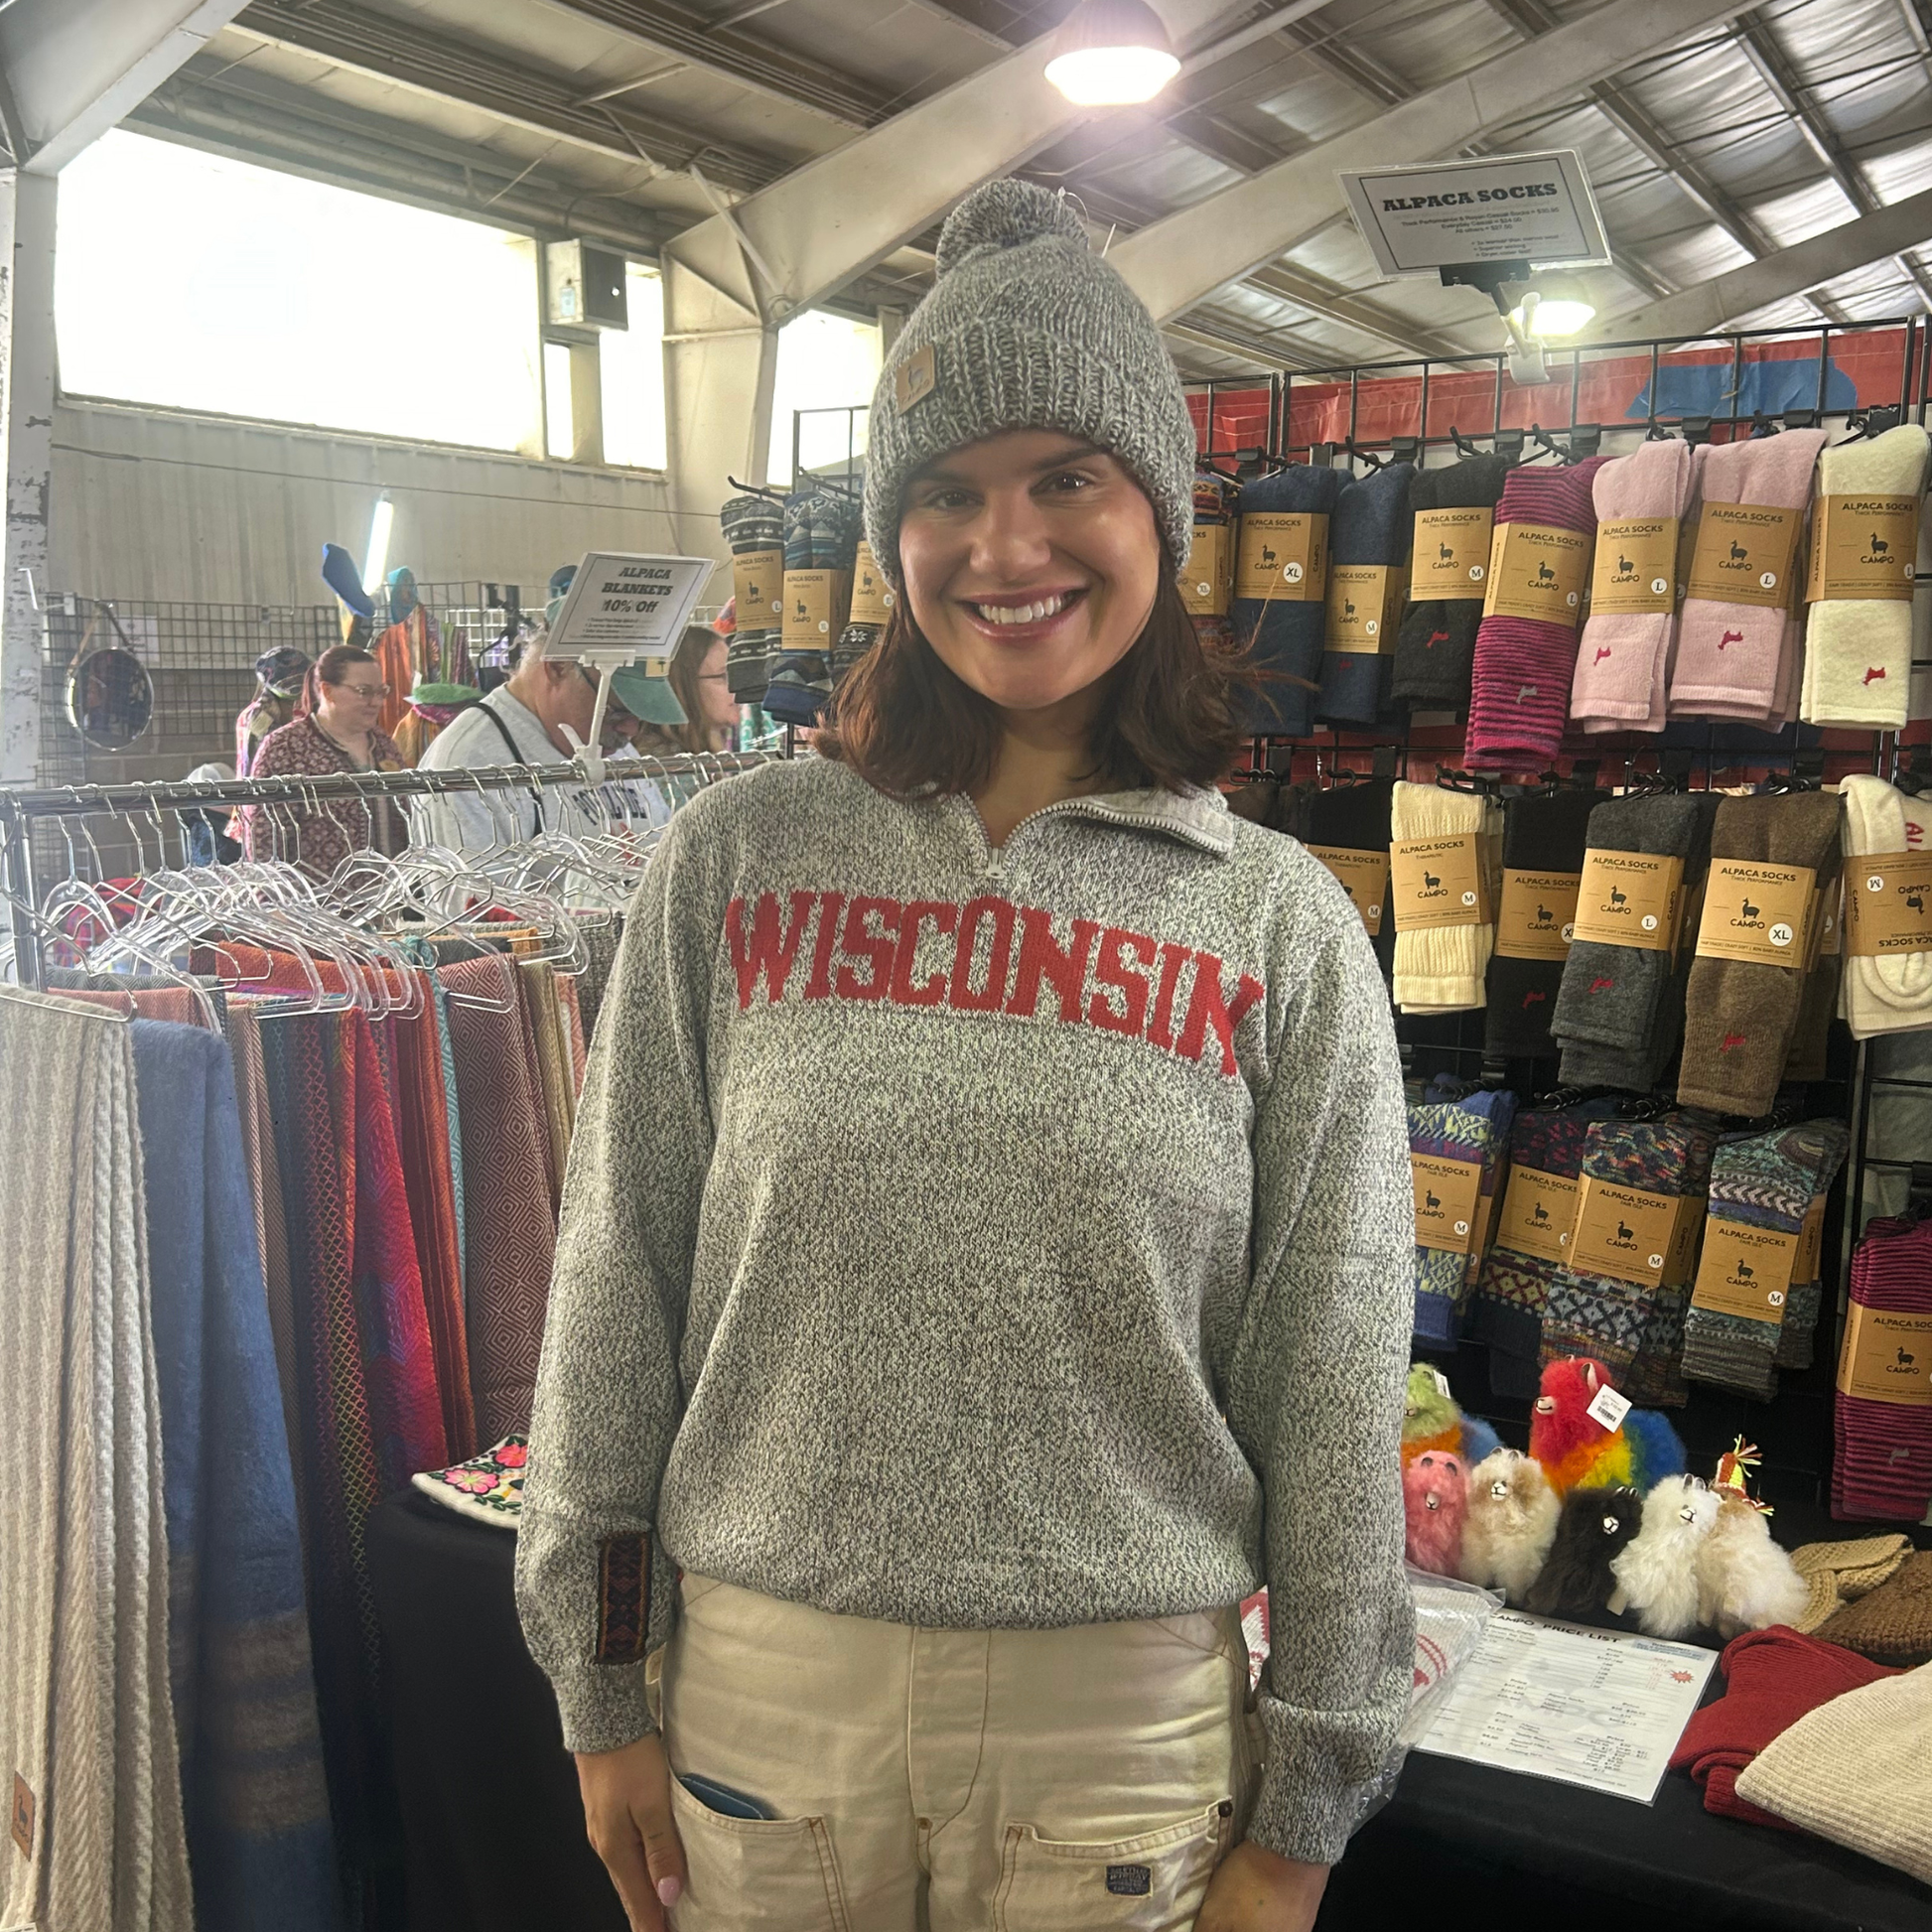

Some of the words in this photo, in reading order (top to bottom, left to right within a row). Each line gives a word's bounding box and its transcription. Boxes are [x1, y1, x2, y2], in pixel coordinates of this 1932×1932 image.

[1383, 192, 1473, 211] ALPACA
[1478, 183, 1557, 203] SOCKS
[1712, 510, 1747, 519] ALPACA
[1750, 513, 1783, 523] SOCKS
[1518, 532, 1554, 541] ALPACA
[1557, 537, 1584, 547] SOCKS
[1719, 561, 1752, 571] CAMPO
[1907, 567, 1912, 576] L
[619, 567, 672, 579] ALPACA
[1286, 568, 1300, 578] XL
[1528, 580, 1559, 591] CAMPO
[1764, 576, 1771, 585] L
[602, 583, 673, 596] BLANKETS
[1570, 595, 1576, 604] L
[635, 601, 659, 613] Off
[1400, 845, 1432, 855] ALPACA
[1434, 841, 1464, 850] SOCKS
[1592, 857, 1625, 867] ALPACA
[1628, 861, 1659, 870] SOCKS
[1721, 868, 1758, 877] ALPACA
[1762, 871, 1796, 882] SOCKS
[1869, 879, 1880, 889] M
[1898, 884, 1930, 895] CAMPO
[1418, 889, 1449, 898] CAMPO
[1600, 905, 1631, 914] CAMPO
[1528, 922, 1559, 931] CAMPO
[1646, 918, 1652, 927] L
[1730, 918, 1765, 929] CAMPO
[1565, 928, 1574, 937] X
[1773, 930, 1789, 939] XL
[1878, 937, 1912, 947] SOCKS
[727, 890, 1264, 1076] WISCONSIN
[1442, 1166, 1469, 1176] SOCKS
[1519, 1173, 1549, 1185] ALPACA
[1551, 1181, 1578, 1192] SOCKS
[1599, 1189, 1634, 1202] ALPACA
[1637, 1197, 1668, 1209] SOCKS
[1416, 1207, 1445, 1219] CAMPO
[1525, 1218, 1552, 1231] CAMPO
[1677, 1227, 1688, 1256] CAMPO
[1719, 1228, 1753, 1241] ALPACA
[1756, 1236, 1786, 1247] SOCKS
[1806, 1226, 1815, 1255] CAMPO
[1606, 1238, 1637, 1251] CAMPO
[1726, 1277, 1758, 1289] CAMPO
[1770, 1294, 1781, 1304] M
[1873, 1317, 1912, 1327] ALPACA
[1886, 1365, 1920, 1374] CAMPO
[1490, 1613, 1535, 1626] CAMPO
[1543, 1624, 1585, 1637] PRICE
[1588, 1633, 1621, 1643] LIST
